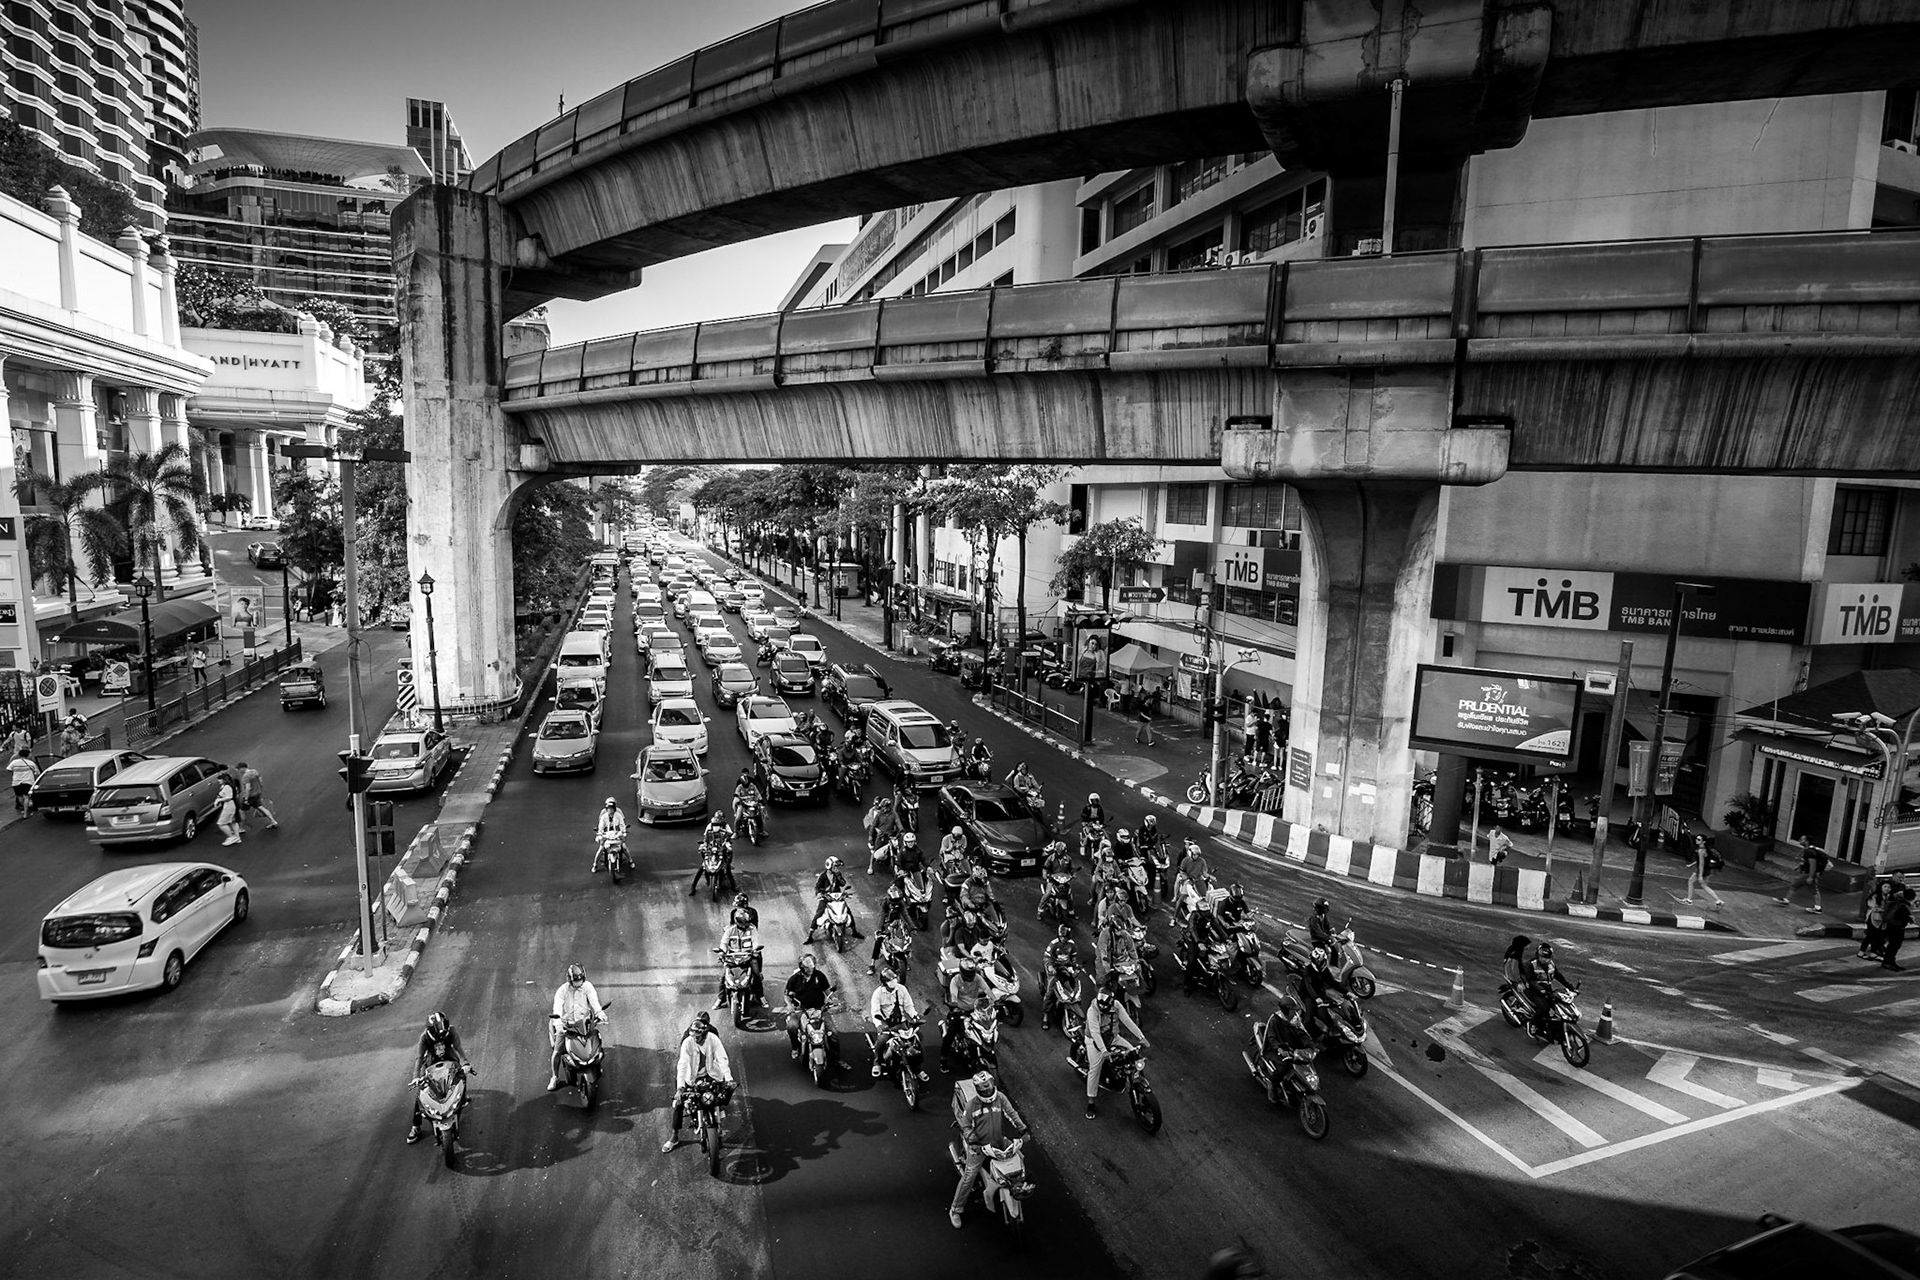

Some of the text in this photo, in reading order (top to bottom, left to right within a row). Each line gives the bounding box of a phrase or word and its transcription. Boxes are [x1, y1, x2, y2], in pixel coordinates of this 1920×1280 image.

[209, 356, 301, 369] AND HYATT
[1225, 552, 1258, 583] TMB
[1507, 578, 1600, 621] TMB
[1621, 606, 1717, 621] ธนาคารทารไทย
[1621, 615, 1672, 627] TMB BAN
[1840, 594, 1892, 636] TMB
[1458, 699, 1530, 718] PRUDENTIAL
